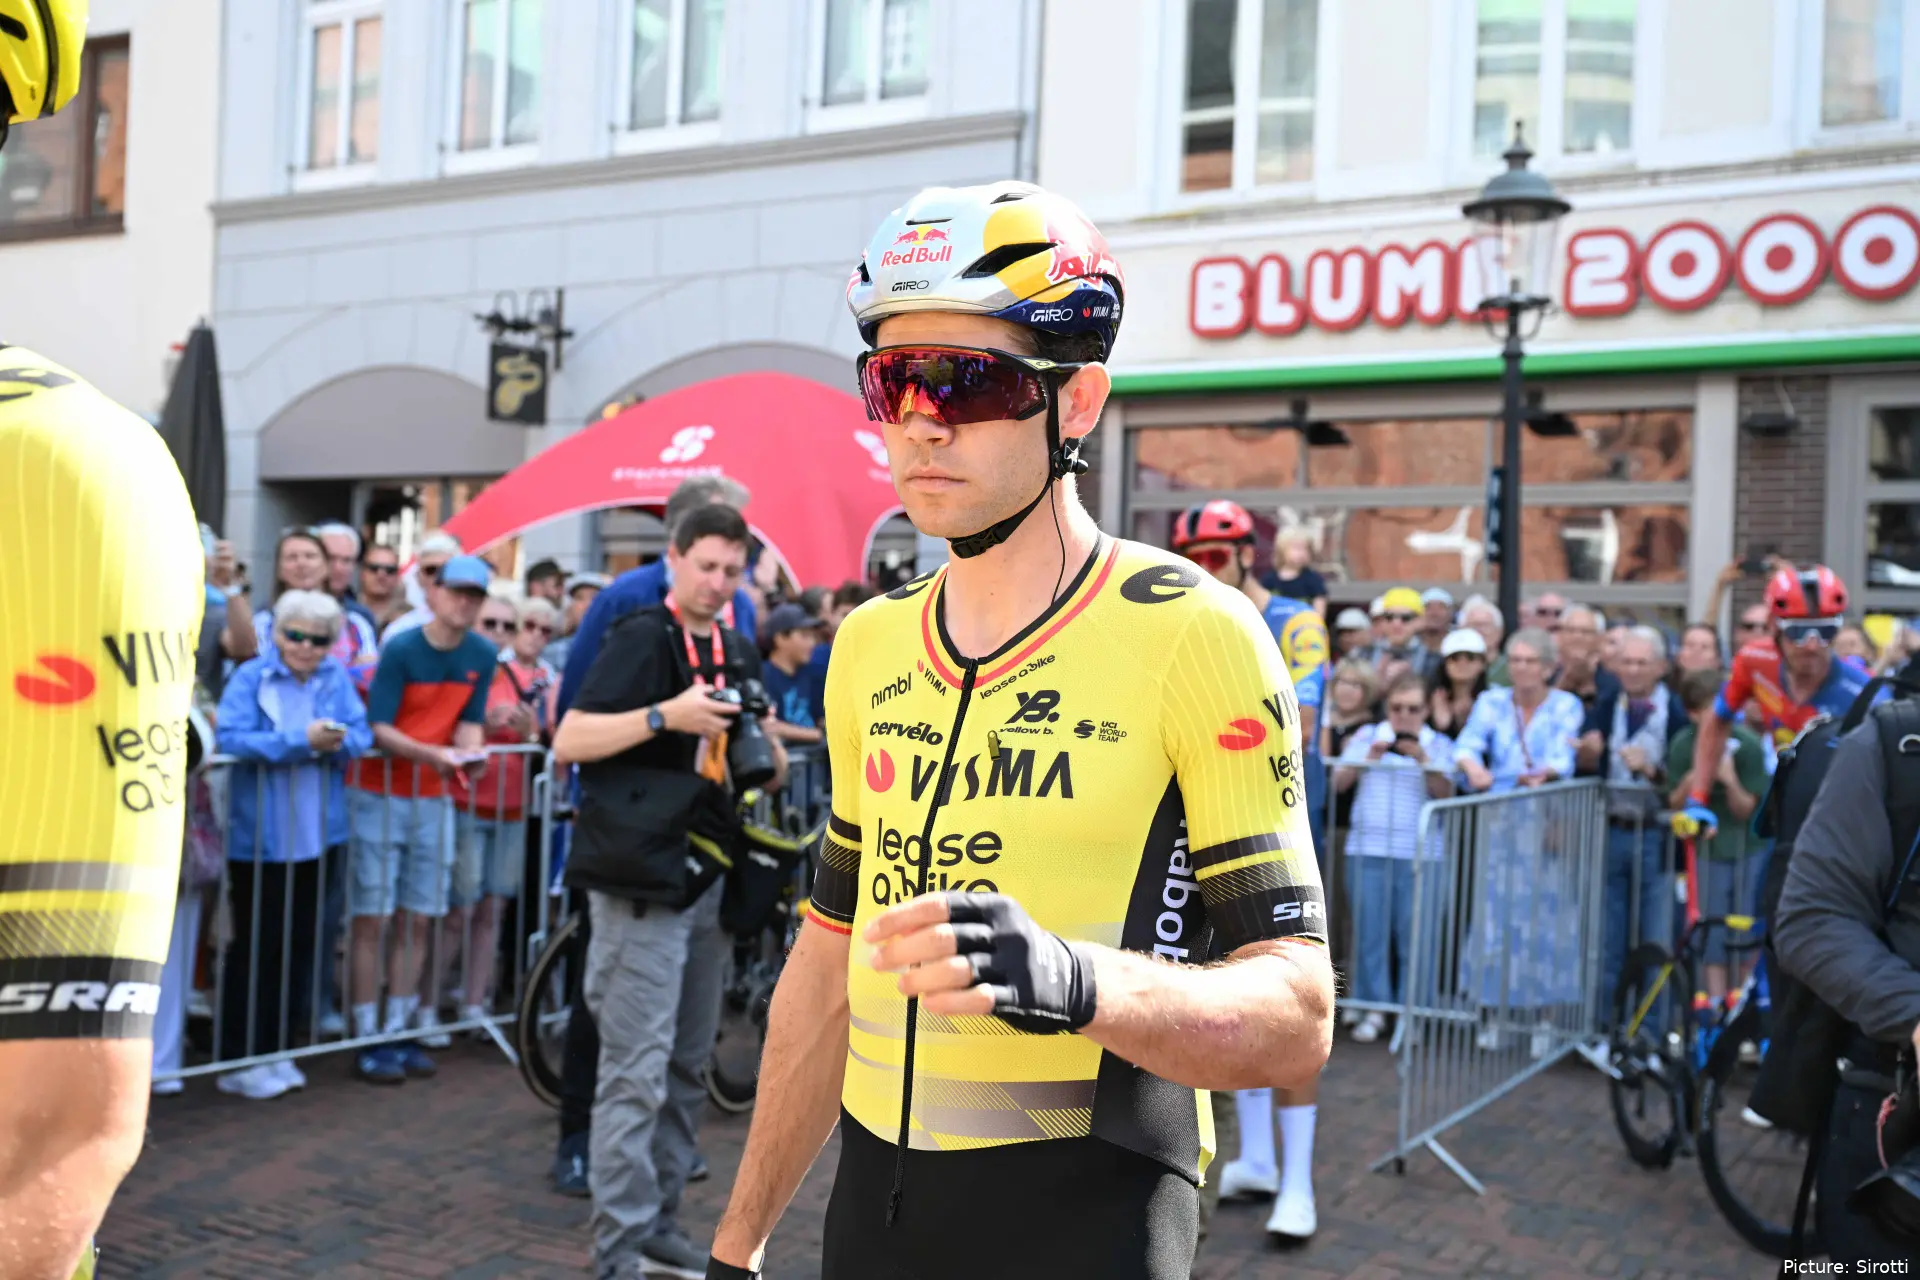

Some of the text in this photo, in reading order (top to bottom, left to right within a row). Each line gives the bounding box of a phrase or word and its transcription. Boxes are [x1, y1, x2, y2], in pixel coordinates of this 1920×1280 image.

[881, 245, 952, 267] Red Bull
[1563, 204, 1920, 318] 2000
[871, 672, 912, 709] nimbl
[924, 667, 947, 696] VISMA
[980, 675, 1017, 700] lease
[1026, 654, 1056, 672] bike
[870, 721, 943, 746] cervélo
[999, 727, 1040, 735] yellow
[1098, 734, 1119, 743] TEAM
[1099, 728, 1127, 738] WORLD
[1101, 721, 1118, 729] UCI
[911, 747, 1074, 807] VISMA
[876, 817, 1003, 868] lease
